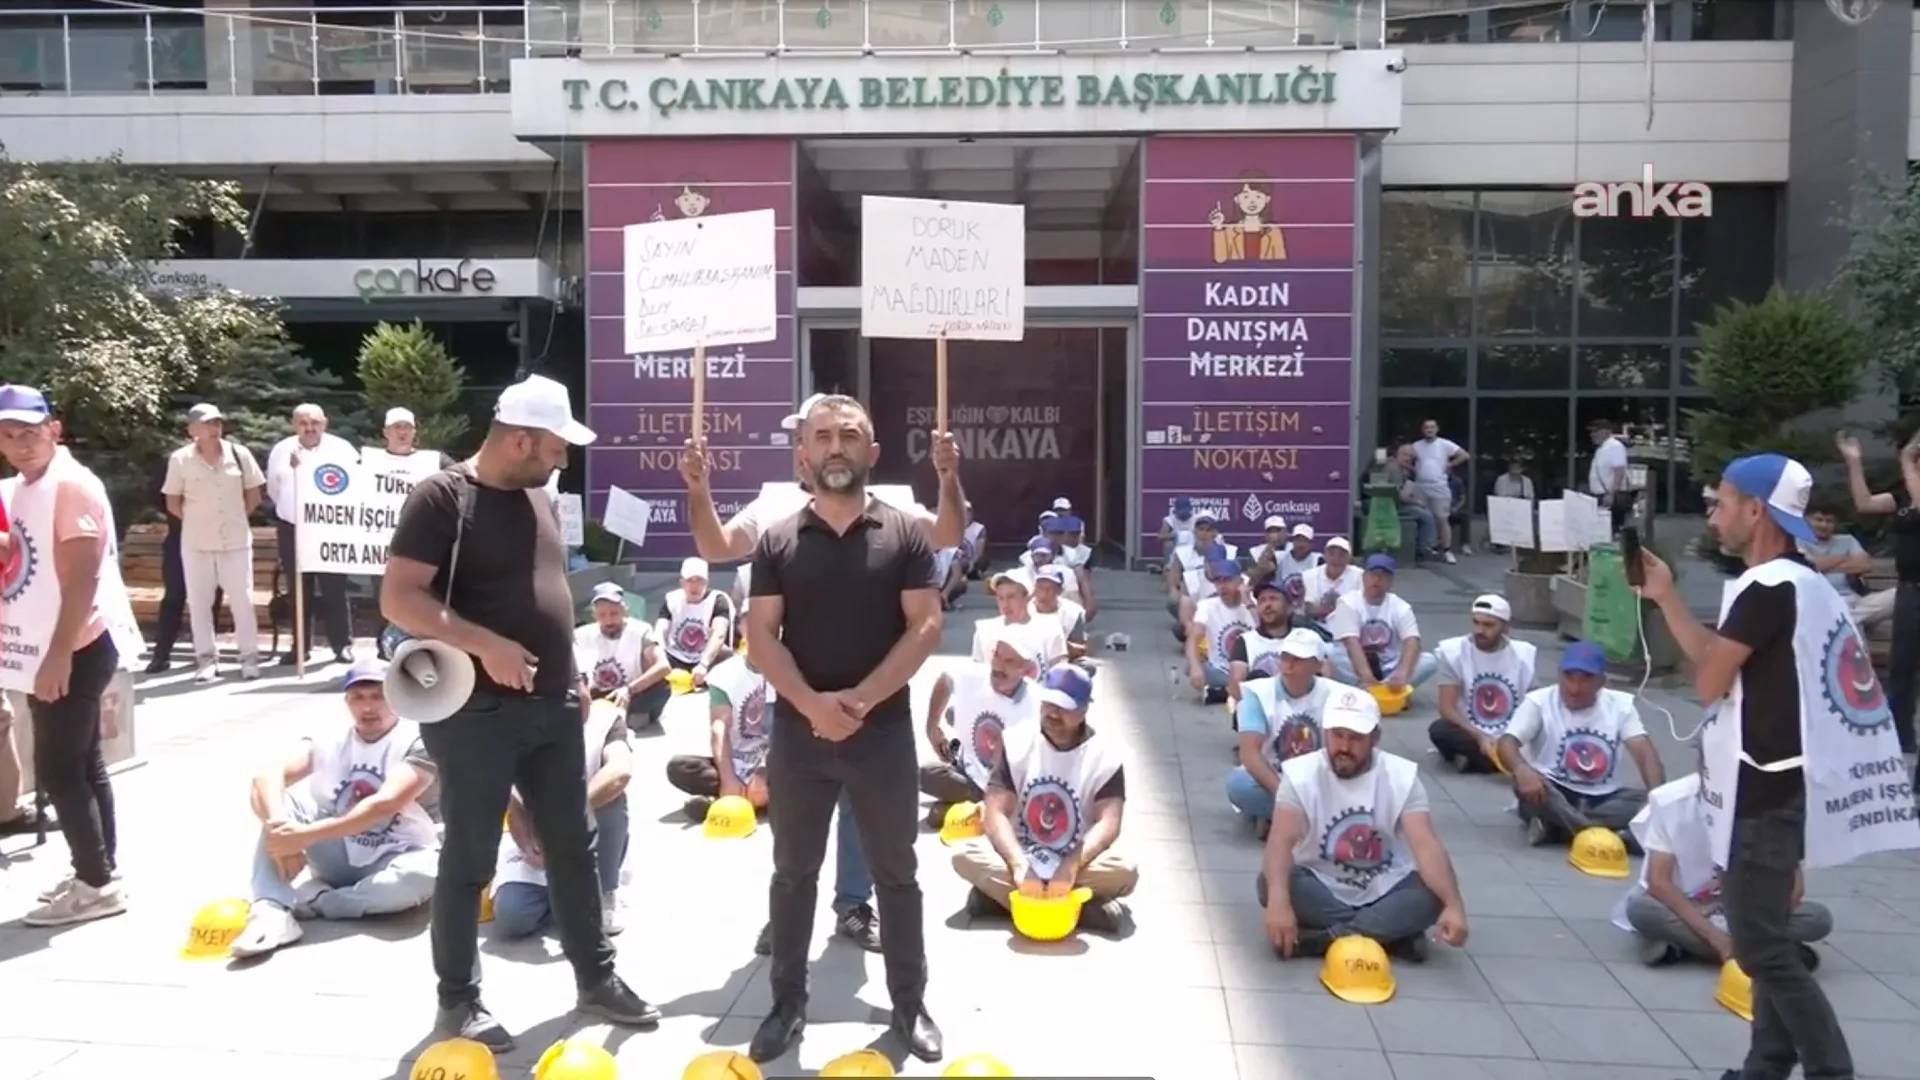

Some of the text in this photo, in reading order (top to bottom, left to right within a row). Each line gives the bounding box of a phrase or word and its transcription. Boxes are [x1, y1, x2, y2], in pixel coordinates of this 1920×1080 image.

[649, 76, 849, 117] ÇANKAYA
[858, 68, 1064, 110] BELEDİYE
[1076, 64, 1337, 112] BAŞKANLIĞI
[912, 216, 981, 241] DORUK
[640, 235, 697, 263] SAYIN
[905, 245, 990, 273] MADEN
[638, 297, 672, 318] DUY
[871, 283, 1011, 317] MAĞDURLARI
[1205, 282, 1290, 307] KADIN
[1187, 317, 1308, 349] DANIŞMA
[633, 346, 746, 379] MEREZİ
[1189, 345, 1305, 377] MERKEZİ
[638, 408, 742, 434] İLETŞİM
[1010, 405, 1061, 424] KALBİ
[1193, 406, 1299, 437] İLETİŞİM
[906, 427, 1061, 464] ÇNKAYA
[1193, 449, 1298, 470] NOKTASI
[304, 501, 398, 533] MADEN İŞÇİL
[320, 541, 390, 565] ORTA ANA
